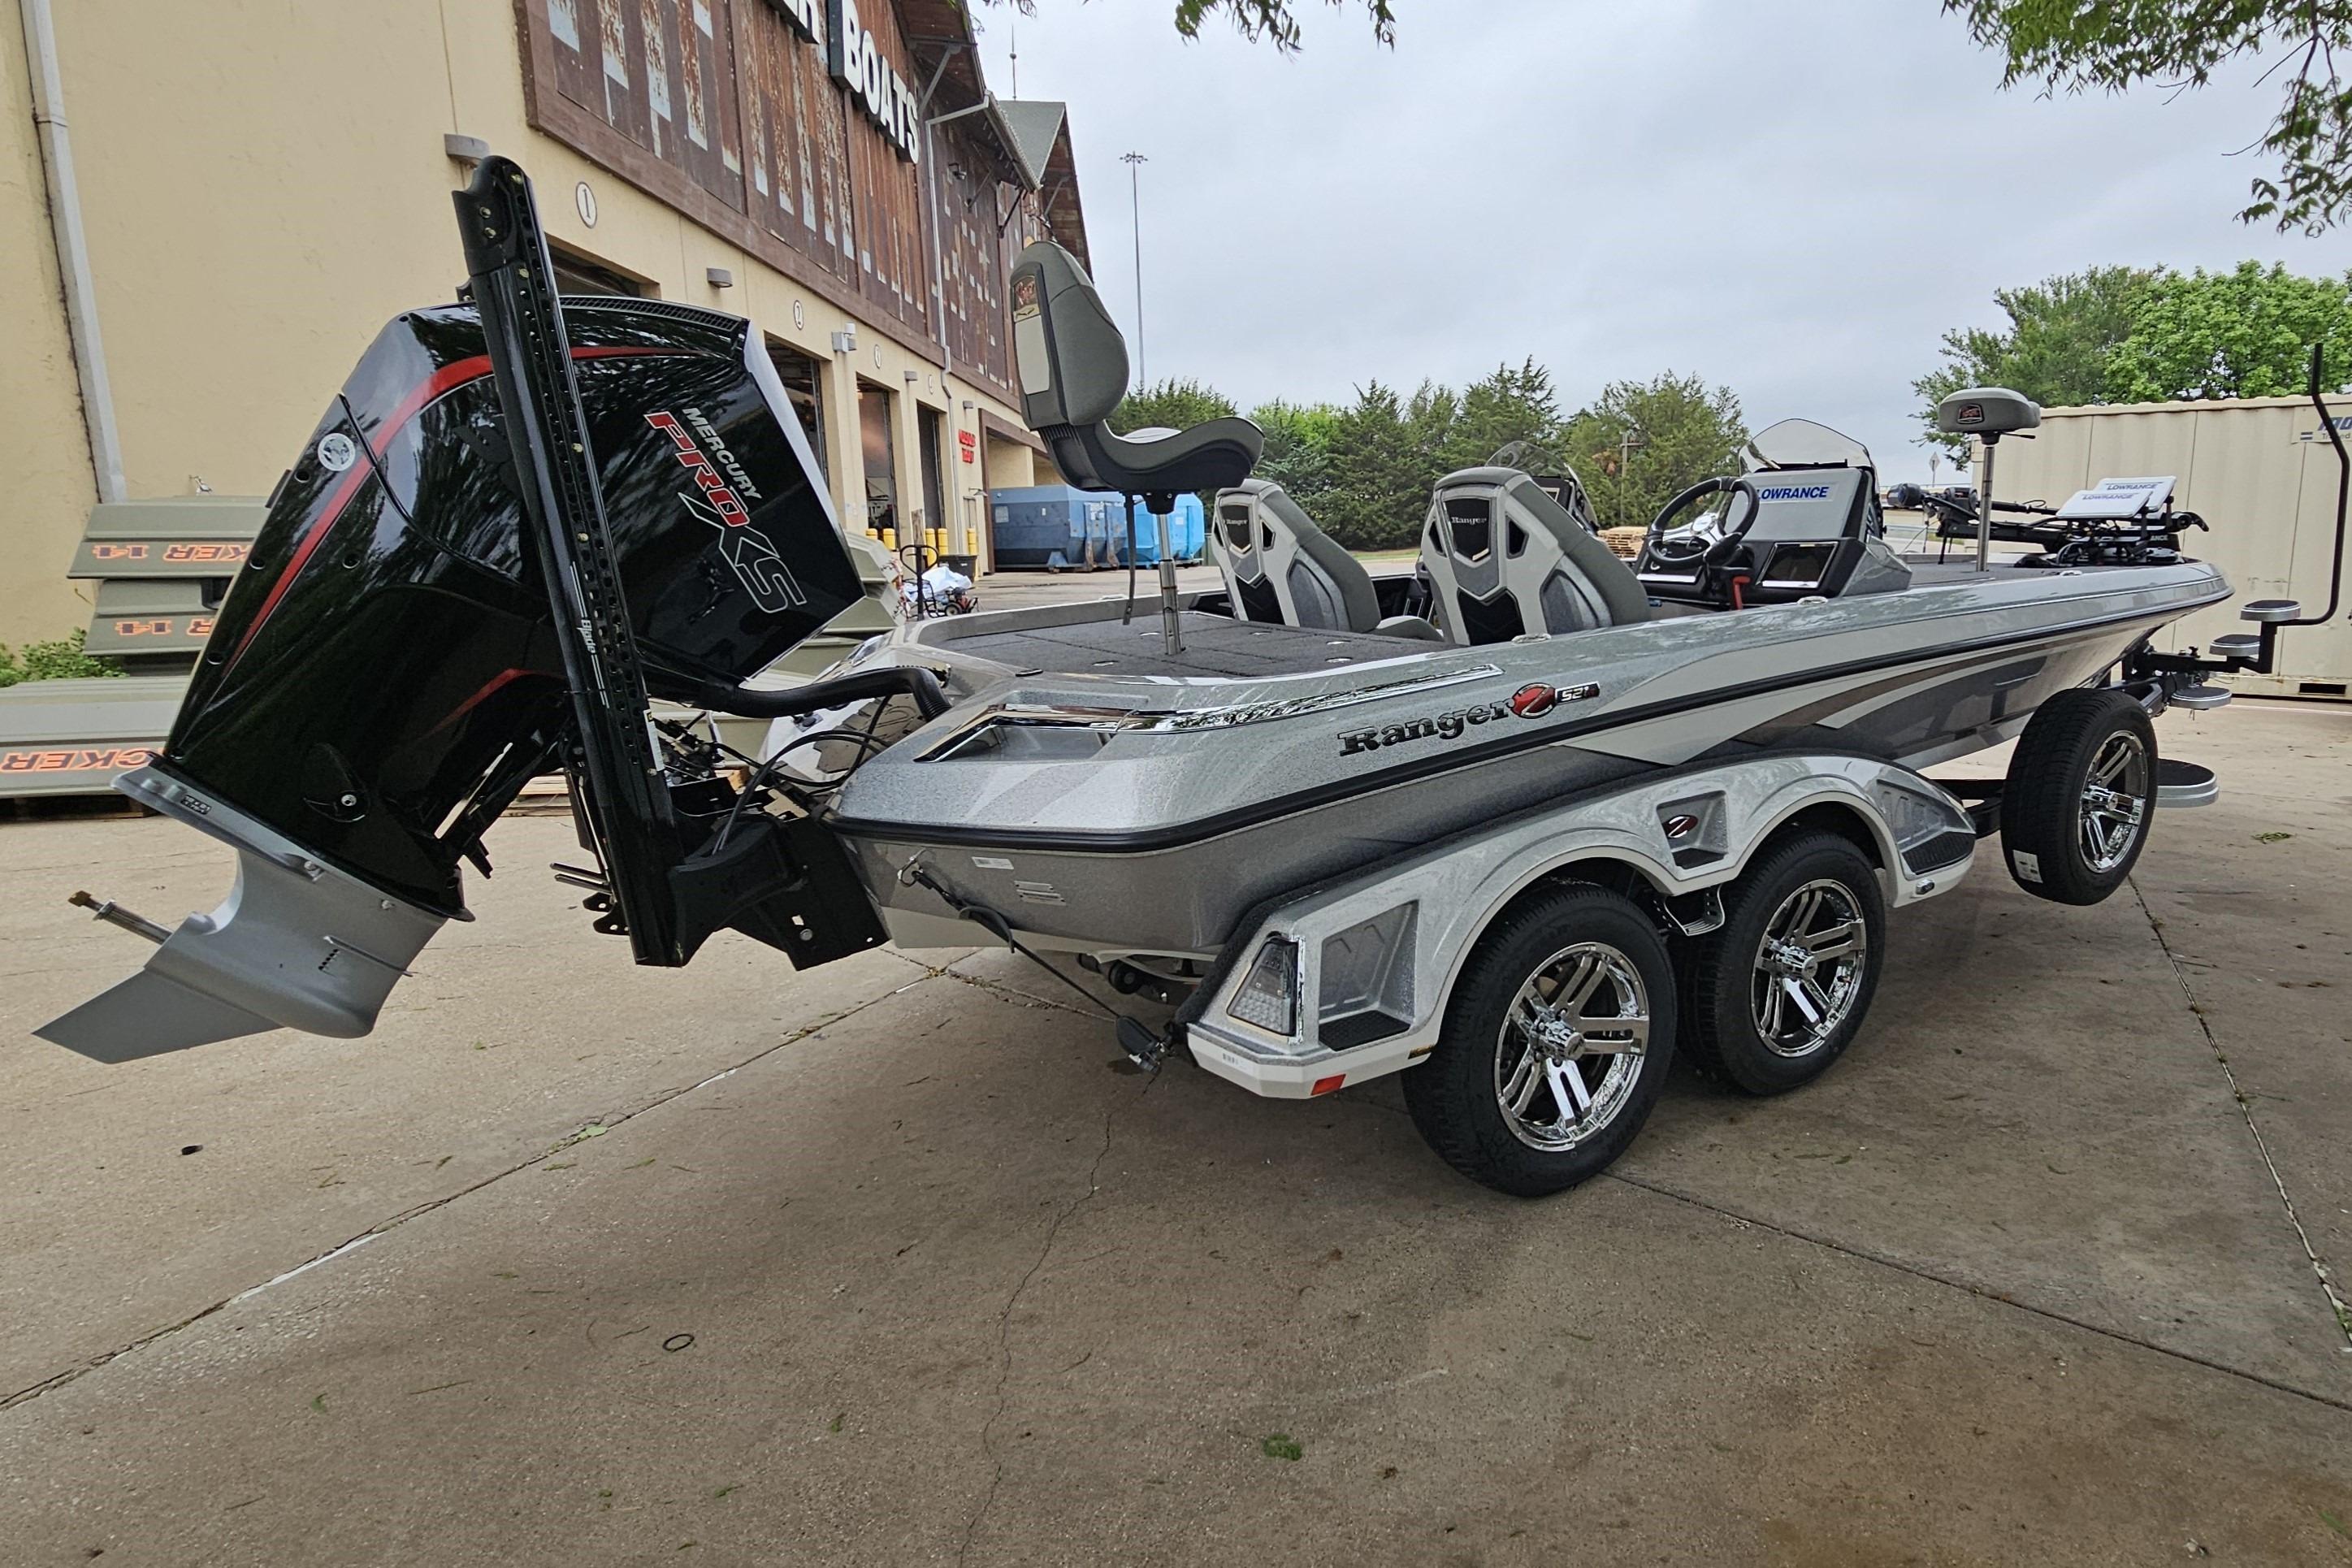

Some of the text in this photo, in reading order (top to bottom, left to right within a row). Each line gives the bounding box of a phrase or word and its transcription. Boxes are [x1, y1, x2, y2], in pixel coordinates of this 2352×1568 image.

[842, 0, 920, 164] BOATS
[643, 410, 751, 527] PRO
[682, 407, 763, 500] MERCURY
[1757, 487, 1830, 500] OWRANCE
[1451, 516, 1487, 526] Ranger
[92, 544, 149, 560] 14
[677, 486, 808, 613] XS
[115, 619, 172, 636] 14
[576, 619, 597, 655] Blade
[1337, 697, 1515, 756] Ranger
[0, 747, 165, 773] CKER
